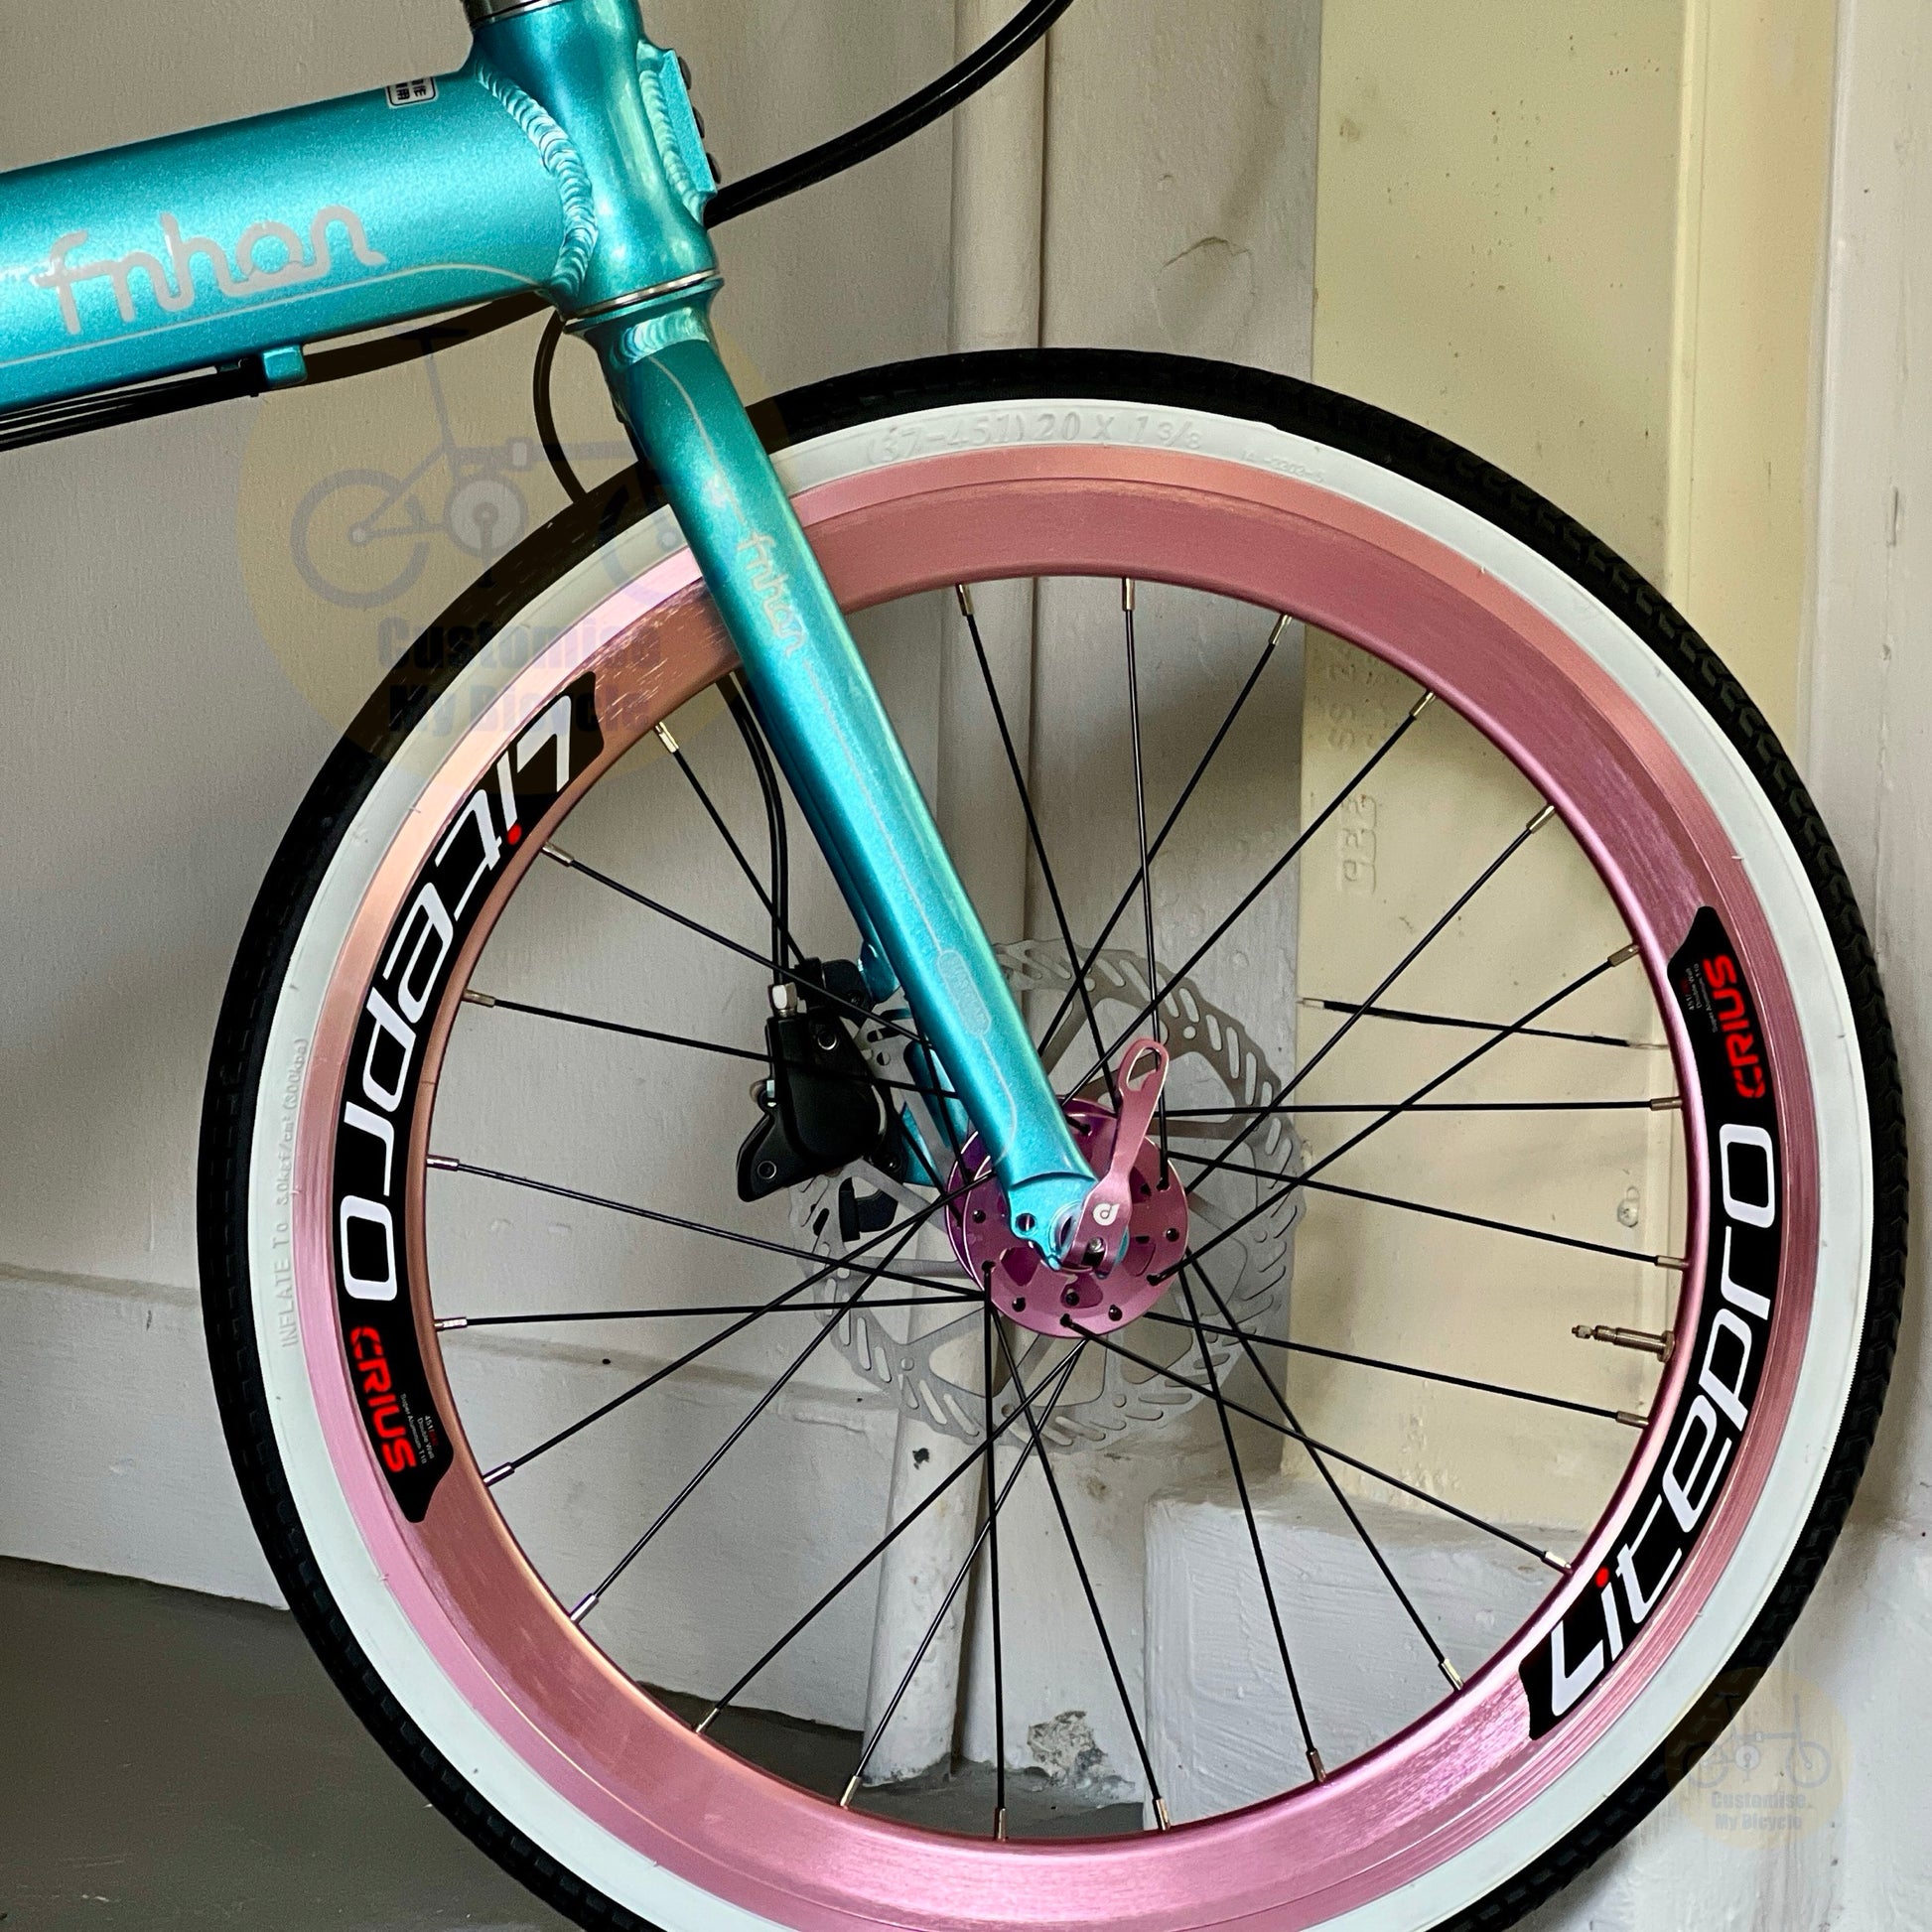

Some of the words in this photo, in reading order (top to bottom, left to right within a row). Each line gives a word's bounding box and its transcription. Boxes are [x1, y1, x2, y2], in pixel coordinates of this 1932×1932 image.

[32, 205, 388, 336] fnhan
[1035, 411, 1082, 442] 20
[737, 529, 808, 658] fnhan
[341, 695, 572, 1301] Litepro
[1703, 954, 1766, 1098] CRIUS
[272, 1258, 299, 1348] INFLATE
[350, 1325, 417, 1473] CRIUS
[1551, 1123, 1774, 1717] Litepro
